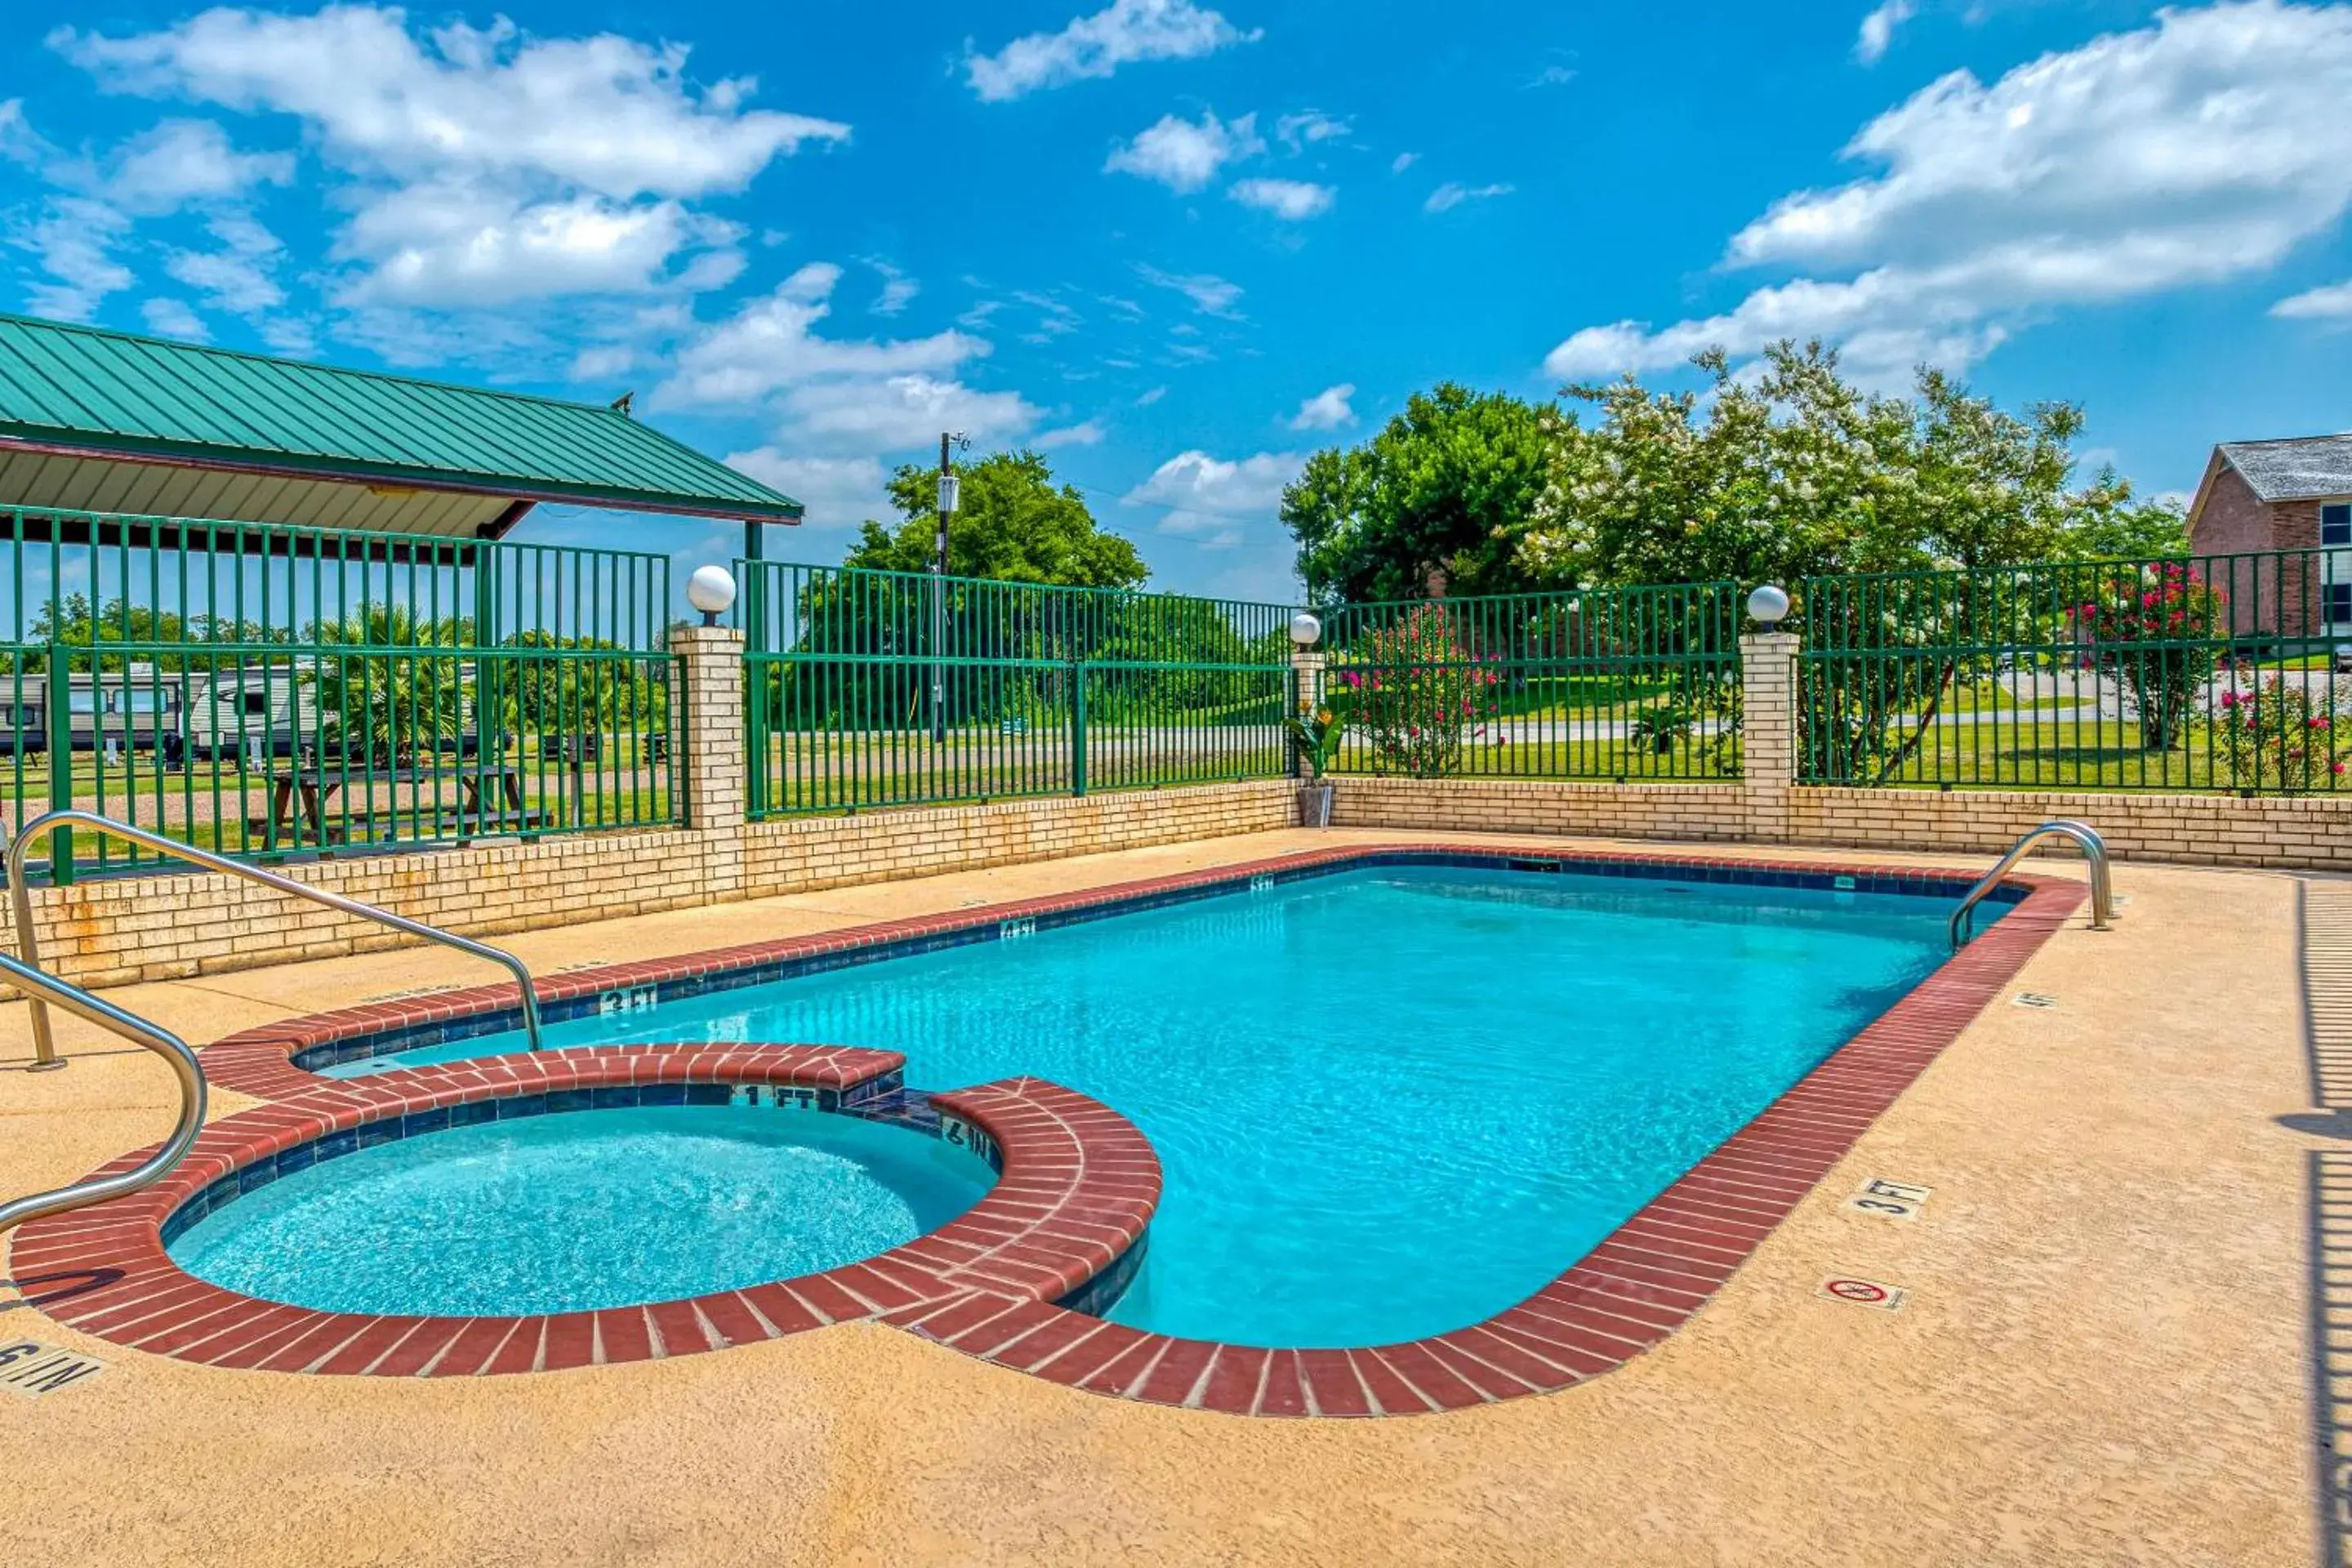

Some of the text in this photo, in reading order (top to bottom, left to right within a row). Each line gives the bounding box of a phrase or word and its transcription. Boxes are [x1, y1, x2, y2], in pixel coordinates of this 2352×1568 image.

[630, 986, 655, 1007] FT
[746, 1086, 814, 1109] 1 FT
[947, 1122, 964, 1145] 6
[7, 1356, 101, 1393] IN
